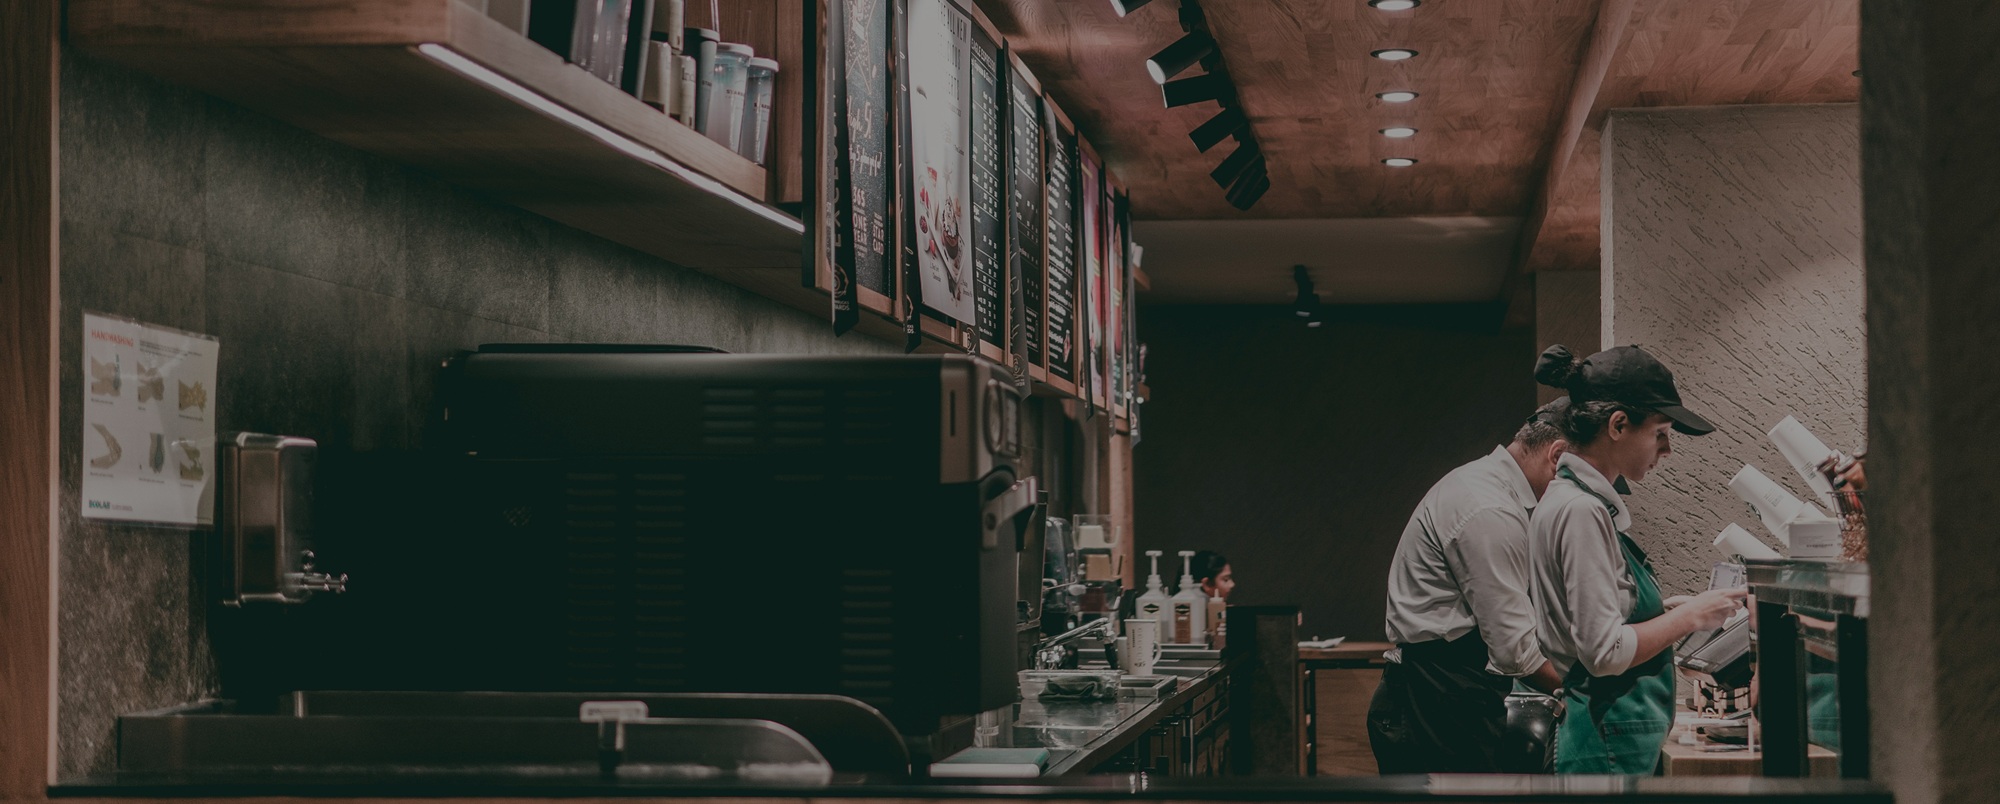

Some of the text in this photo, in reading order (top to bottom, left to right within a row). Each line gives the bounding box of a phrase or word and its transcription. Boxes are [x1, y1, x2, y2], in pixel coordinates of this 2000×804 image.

[852, 186, 866, 208] 365
[852, 212, 868, 232] ONE
[872, 224, 884, 242] STAR
